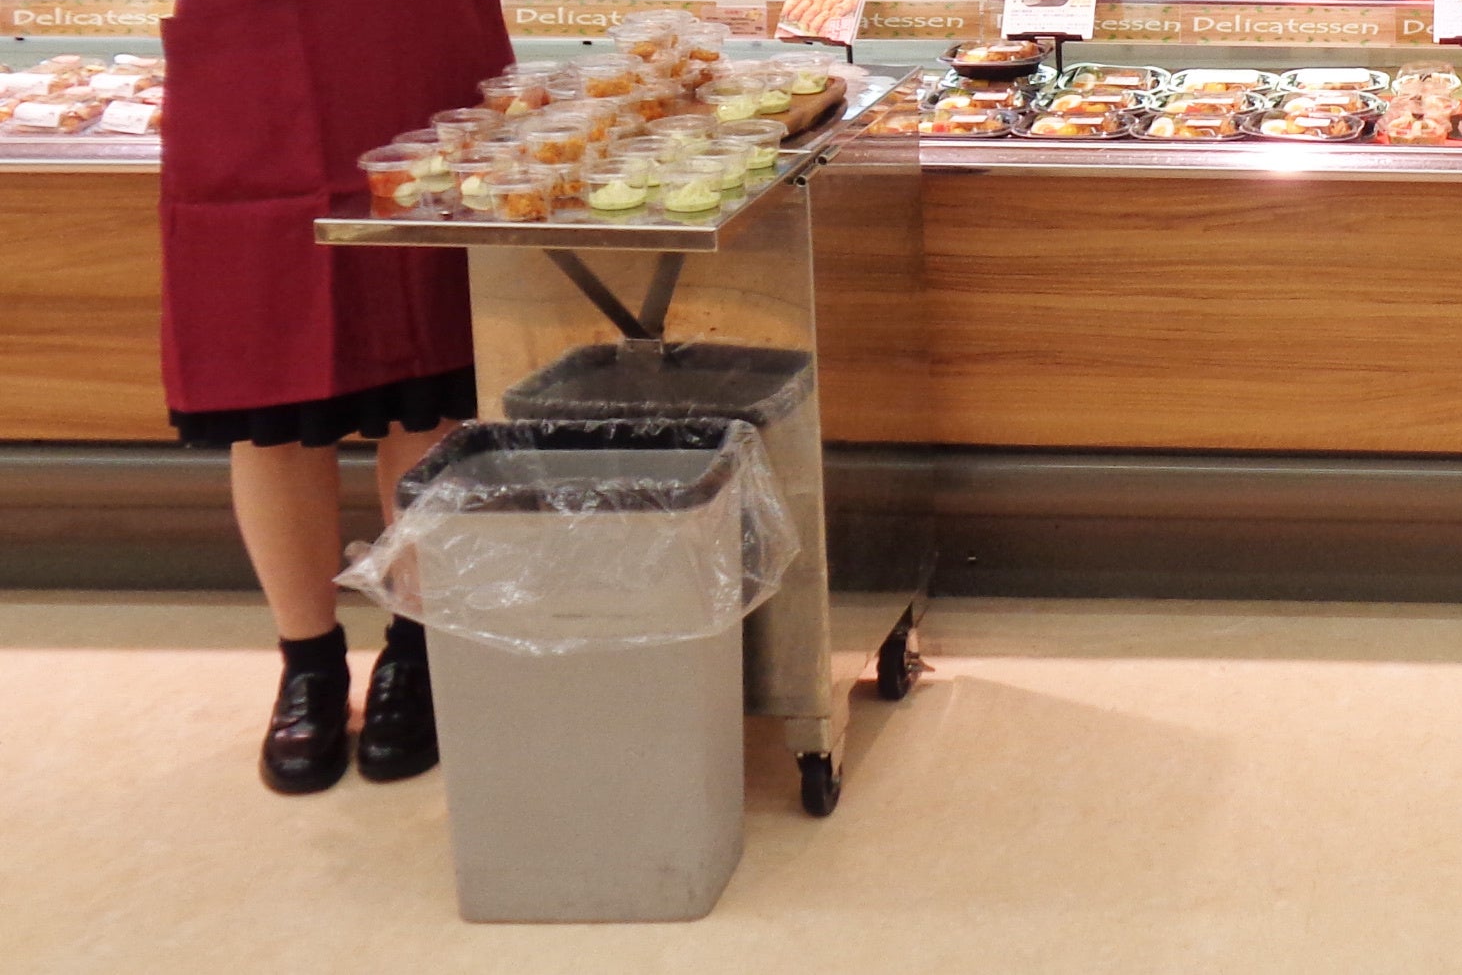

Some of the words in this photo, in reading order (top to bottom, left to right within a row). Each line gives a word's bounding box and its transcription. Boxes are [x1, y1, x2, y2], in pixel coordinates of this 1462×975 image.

[13, 7, 161, 25] Delicatess
[516, 7, 622, 26] Delicat
[860, 14, 964, 29] atessen
[1193, 15, 1379, 35] Delicatessen
